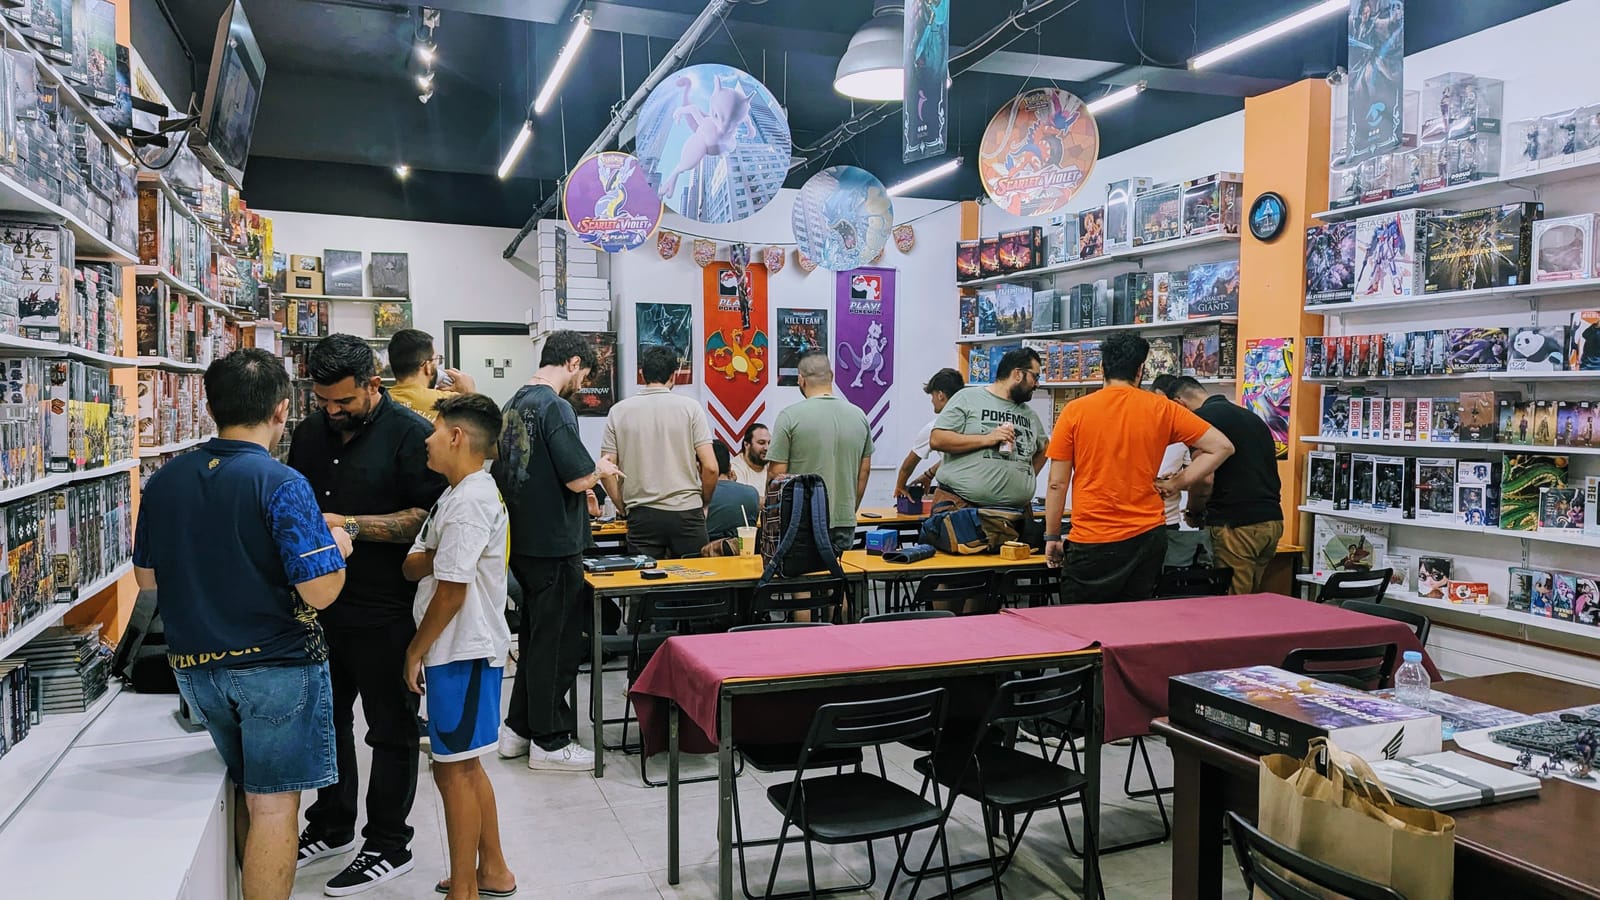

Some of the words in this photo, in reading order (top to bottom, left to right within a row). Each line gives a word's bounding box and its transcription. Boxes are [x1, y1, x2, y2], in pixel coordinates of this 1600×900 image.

[580, 218, 616, 232] SCARLET
[620, 219, 648, 231] VIOLET
[1198, 302, 1229, 312] GIANTS
[801, 317, 820, 325] TEAM
